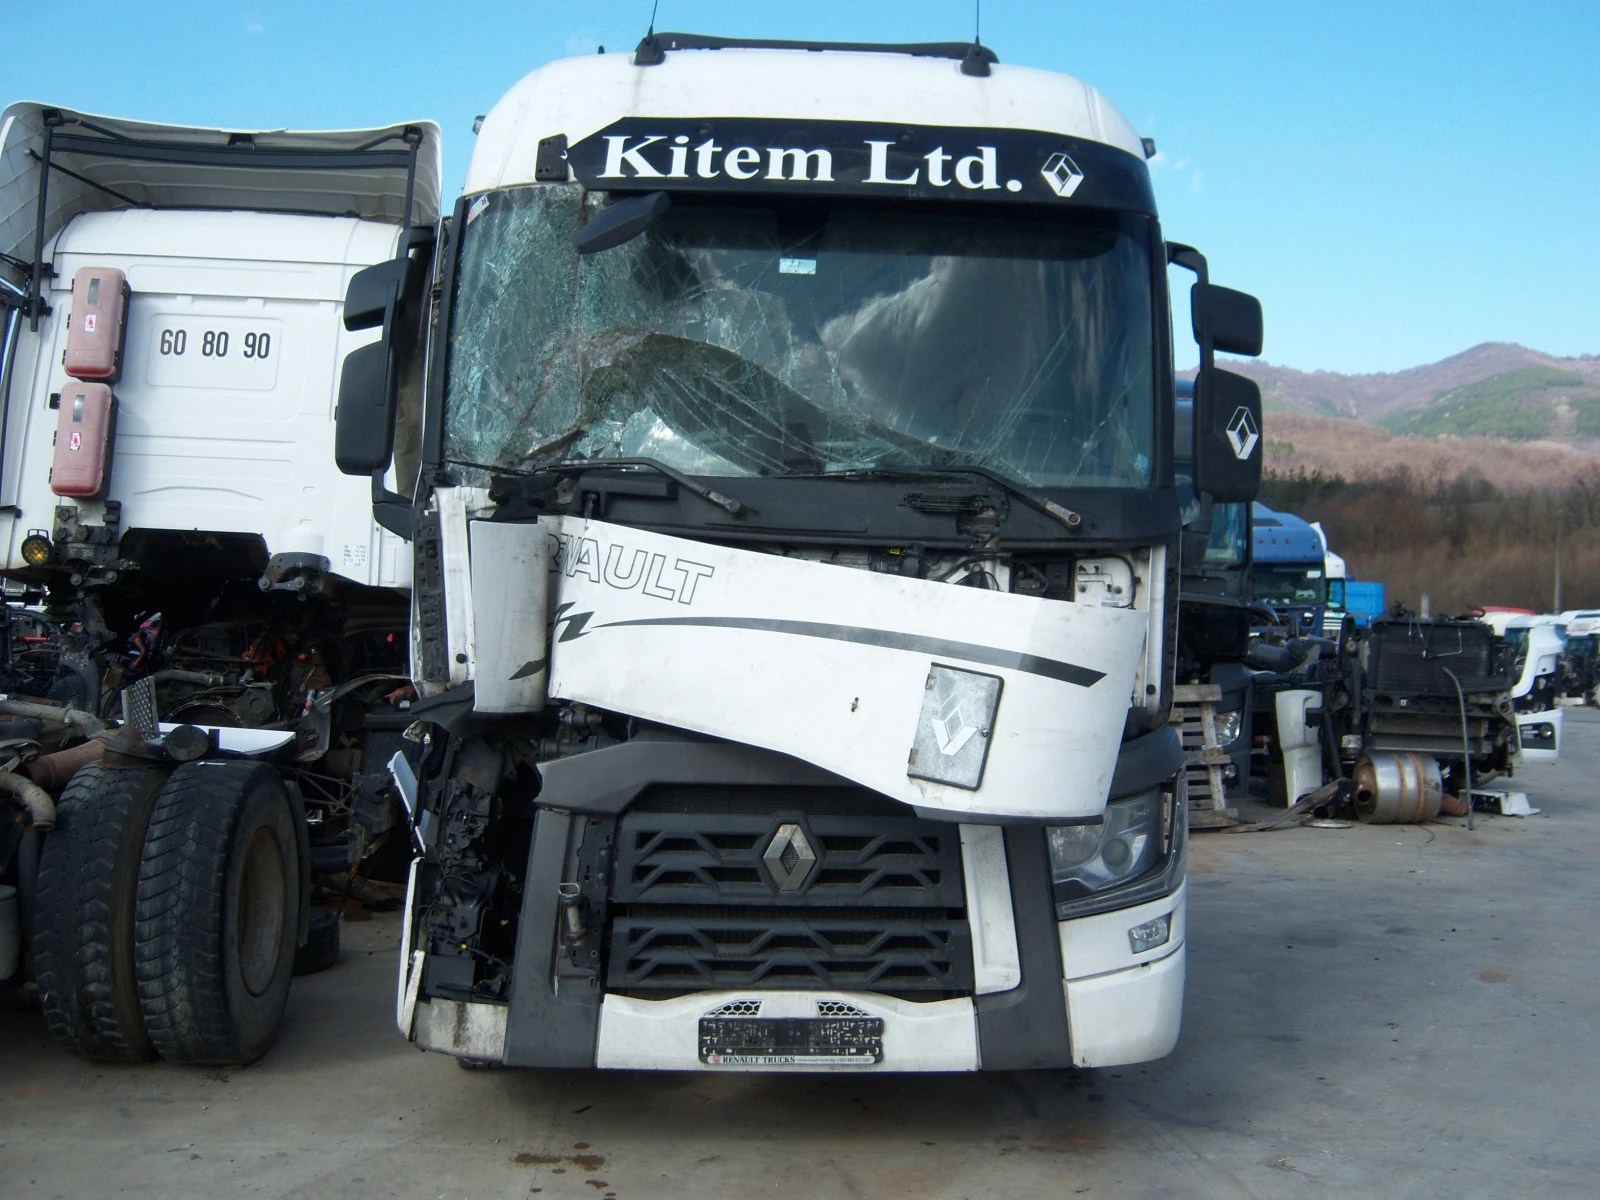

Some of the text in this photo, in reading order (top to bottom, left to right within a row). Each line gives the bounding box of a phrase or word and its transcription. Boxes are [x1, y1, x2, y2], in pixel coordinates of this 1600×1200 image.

[597, 135, 1023, 192] Kitem Ltd.
[160, 328, 271, 359] 60 80 90
[722, 1056, 759, 1064] RENAULT
[763, 1056, 796, 1064] TRUCKS
